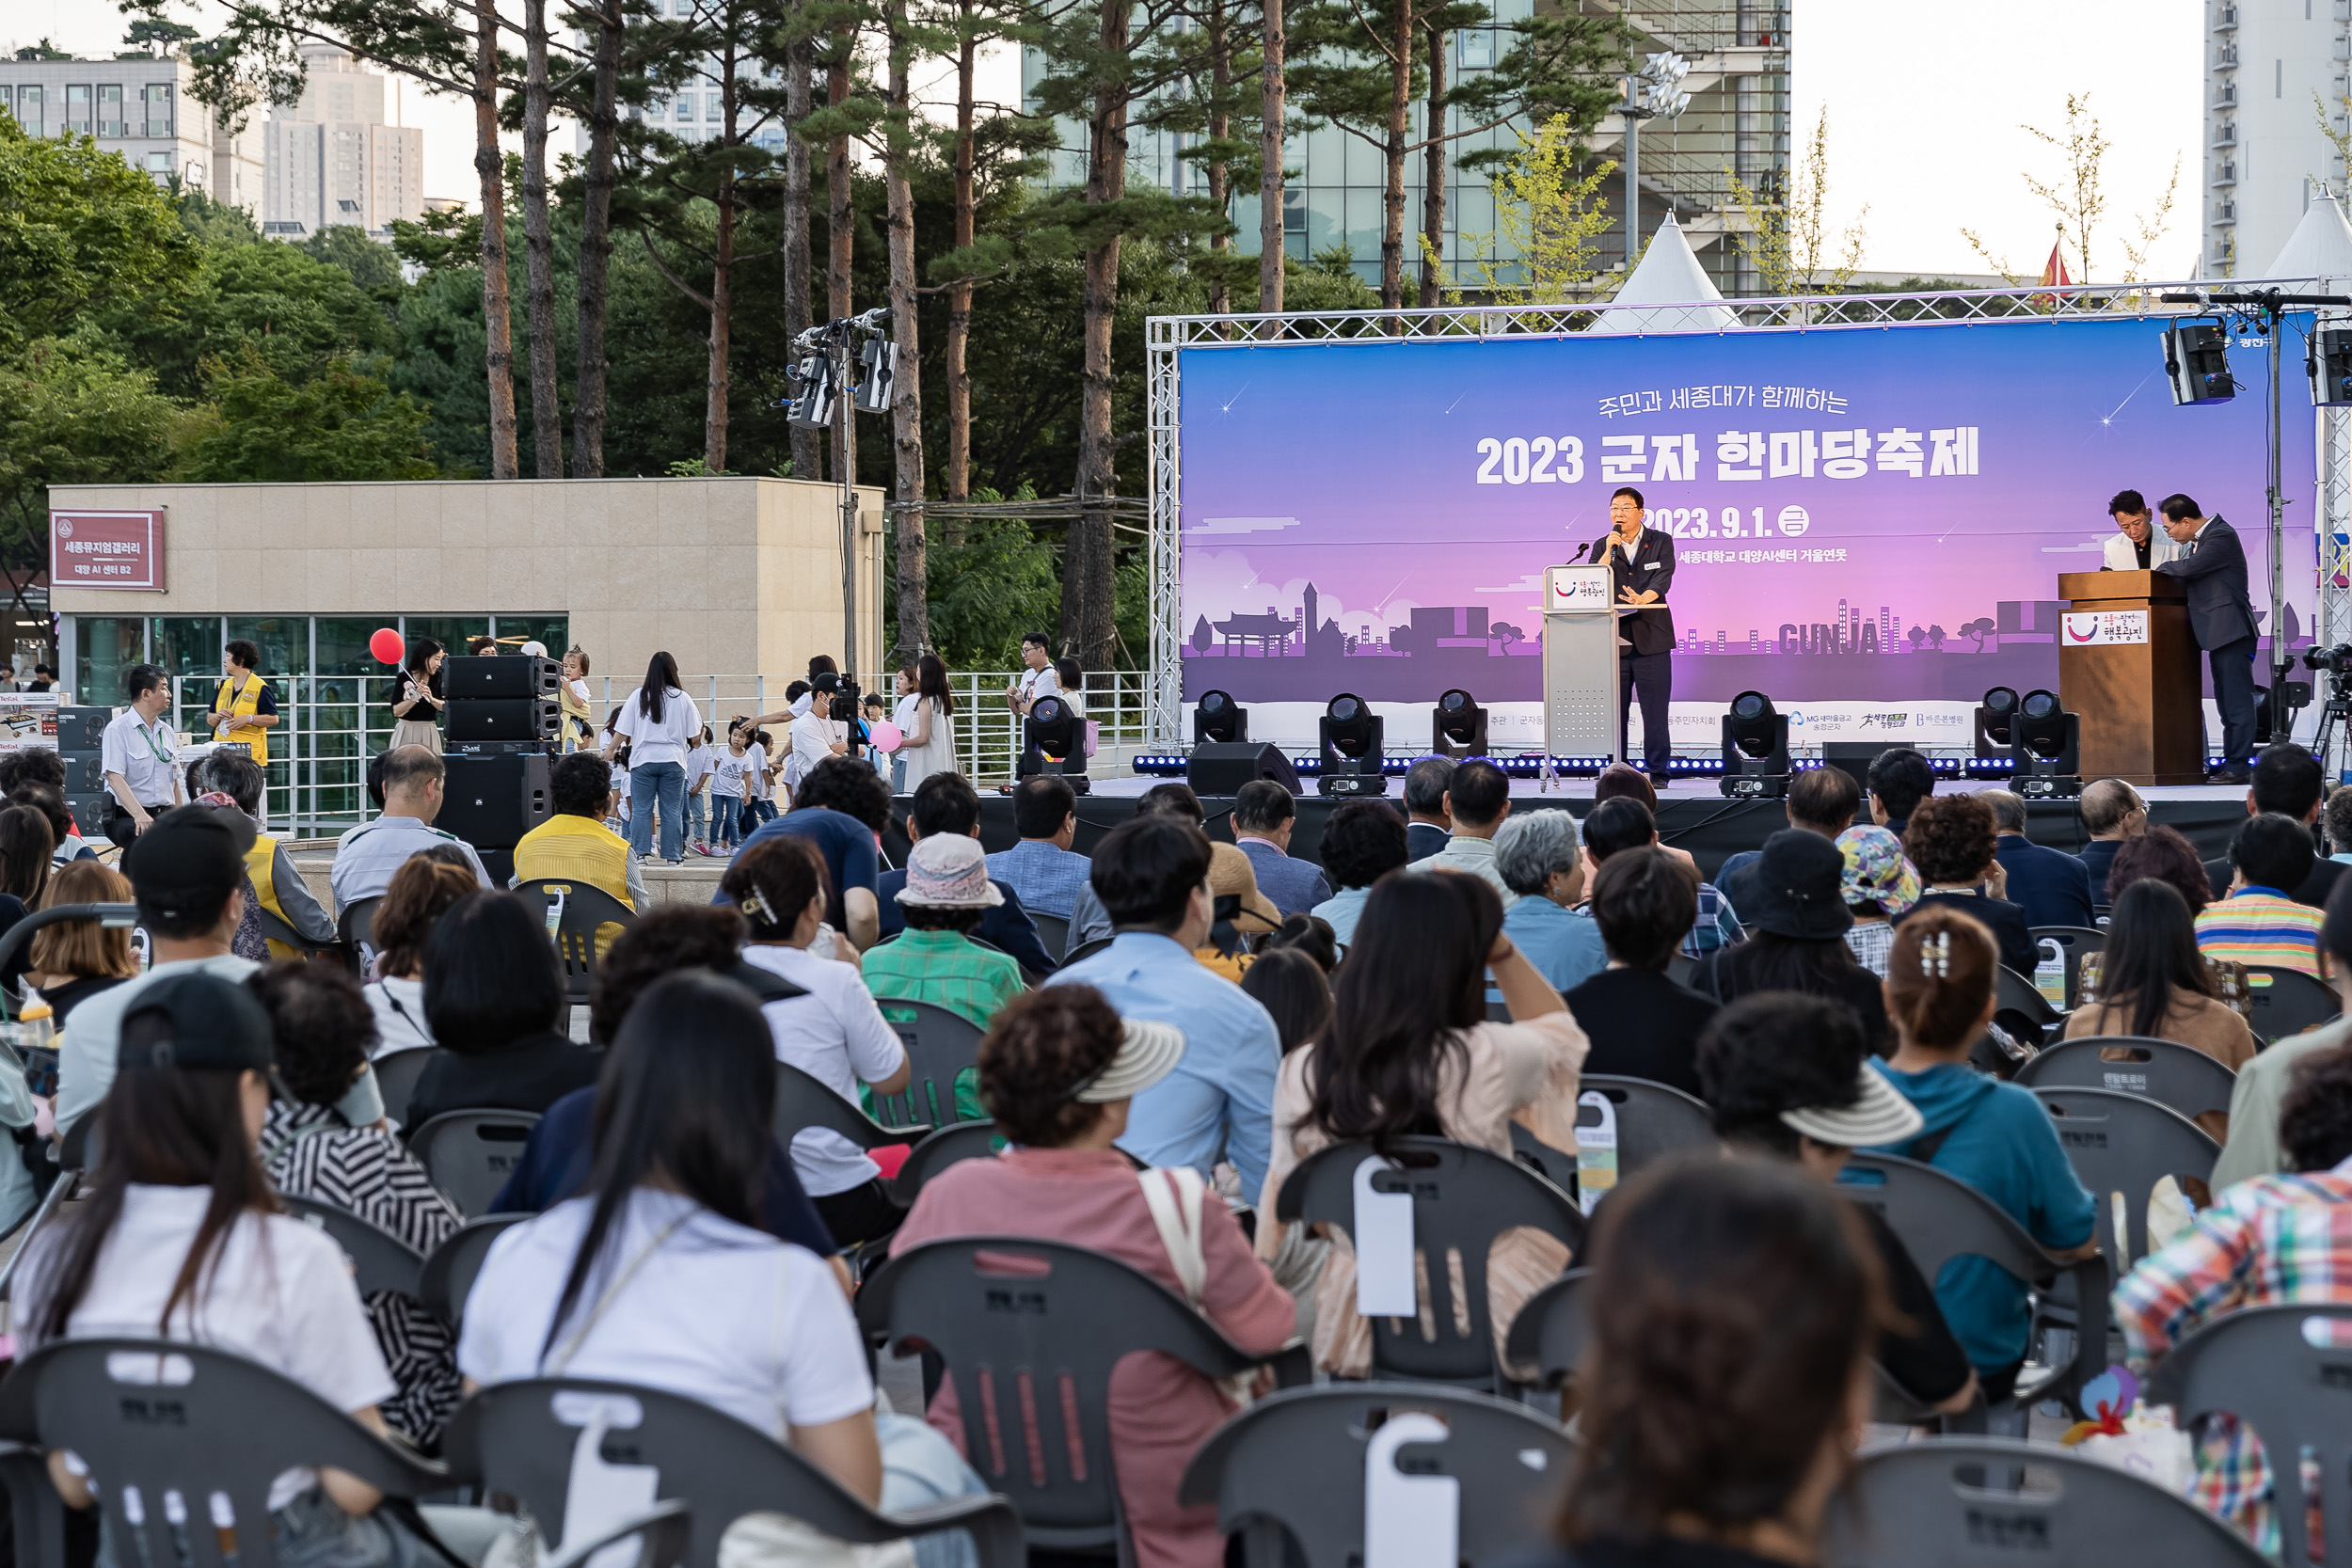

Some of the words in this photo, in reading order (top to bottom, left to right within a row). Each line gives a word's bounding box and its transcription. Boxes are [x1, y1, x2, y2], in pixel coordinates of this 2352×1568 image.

[1598, 392, 1662, 420] 주민과
[1668, 385, 1756, 410] 세종대가
[1761, 386, 1849, 415] 함께하는
[1475, 436, 1585, 485] 2023
[1600, 434, 1700, 483] 군자
[1716, 426, 1979, 482] 한마당축제
[64, 541, 141, 554] 세종뮤지엄갤러리
[1678, 550, 1737, 564] 세종대학교
[1739, 548, 1797, 563] 대양AI센터
[1800, 548, 1848, 563] 거울연못
[74, 564, 90, 576] 대양
[92, 565, 102, 575] AI
[103, 565, 119, 576] 센터
[119, 565, 132, 575] B2
[1779, 623, 1880, 655] GUNJA
[2104, 626, 2142, 641] 행복광진
[1490, 716, 1507, 725] 주관
[1519, 716, 1545, 725] 군자동
[1925, 715, 1963, 724] 바른본병원
